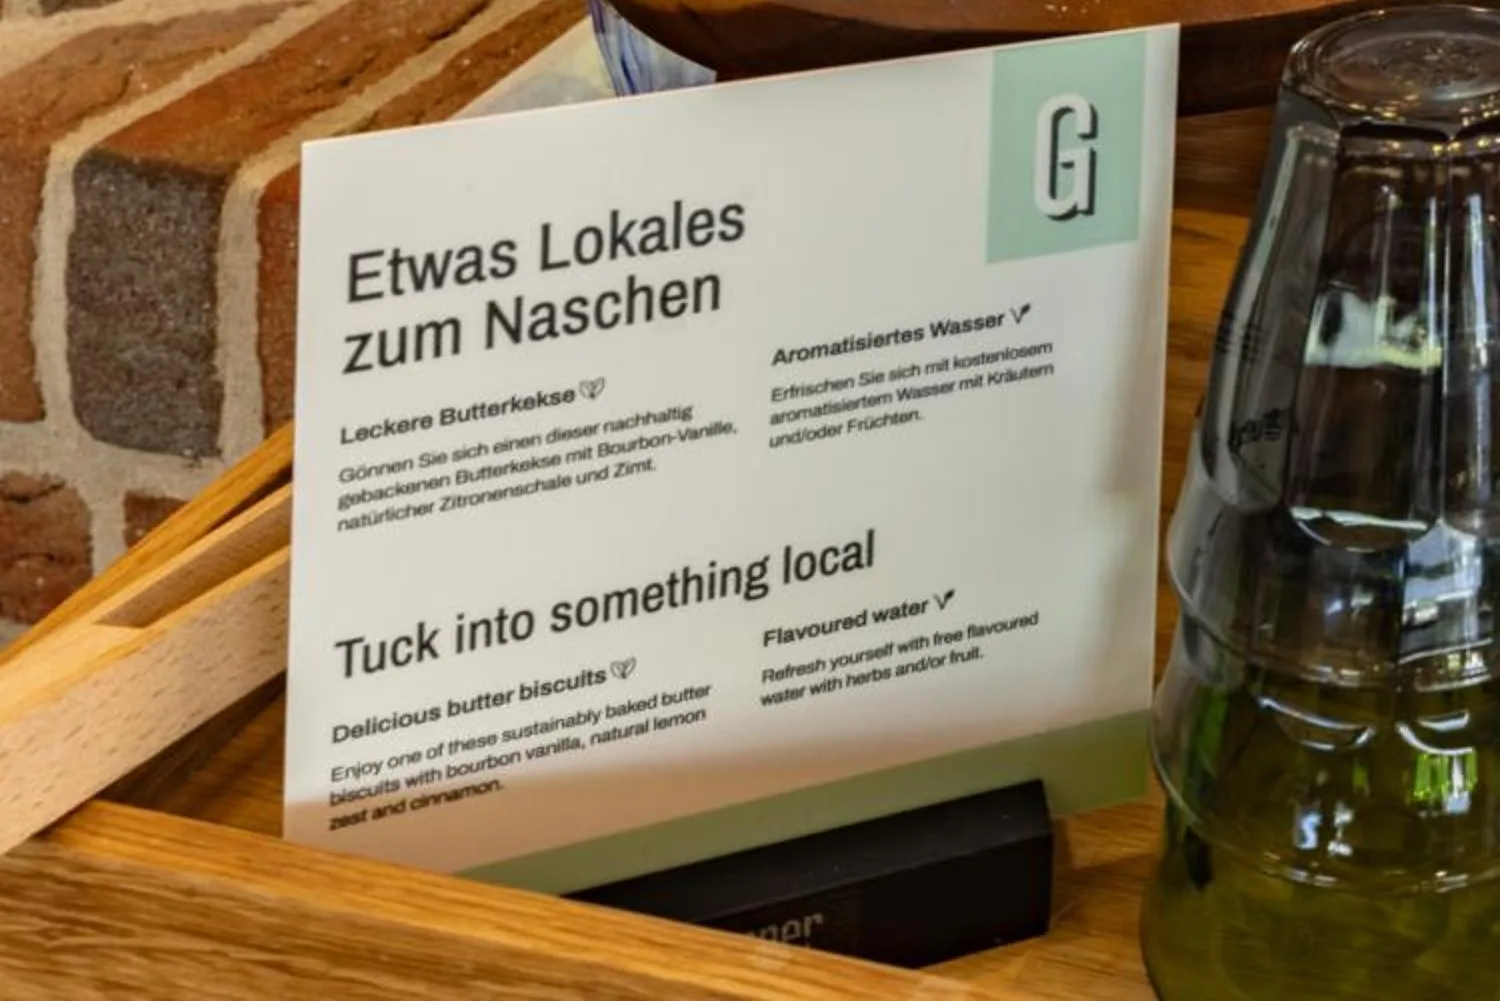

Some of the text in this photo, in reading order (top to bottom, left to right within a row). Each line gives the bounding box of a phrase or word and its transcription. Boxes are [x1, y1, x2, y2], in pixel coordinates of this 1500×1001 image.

[1034, 92, 1098, 221] G
[346, 199, 746, 303] Etwas Lokales
[341, 272, 722, 375] zum Naschen
[771, 313, 1005, 366] Aromatisiertes Wasser
[770, 363, 1054, 426] aromatisiertem Wasser mit Kräutern
[771, 342, 1053, 402] Erfrischen Sie sich mit kostenlosem
[338, 405, 694, 484] Gönnen Sie sich einen dieser nachhaltig
[340, 388, 576, 445] Leckere Butterkekse
[769, 410, 923, 448] und/oder Früchten.
[337, 474, 451, 511] gebackenen
[455, 452, 562, 485] Butterkekse
[565, 447, 593, 465] mit
[337, 457, 657, 532] natürlicher Zitronenschale und Zimt.
[335, 529, 876, 679] Tuck into something local
[763, 599, 929, 648] Flavoured water
[760, 646, 985, 707] water with herbs and/or fruit.
[761, 610, 1040, 683] Refresh yourself with free flavoured
[331, 684, 712, 783] Enjoy one of these sustainably baked butter
[332, 668, 607, 744] Delicious butter biscuits
[329, 709, 707, 807] biscuits with bourbon vanilla, natural lemon
[328, 779, 505, 831] zest and cinnamon.
[744, 912, 824, 945] ner
